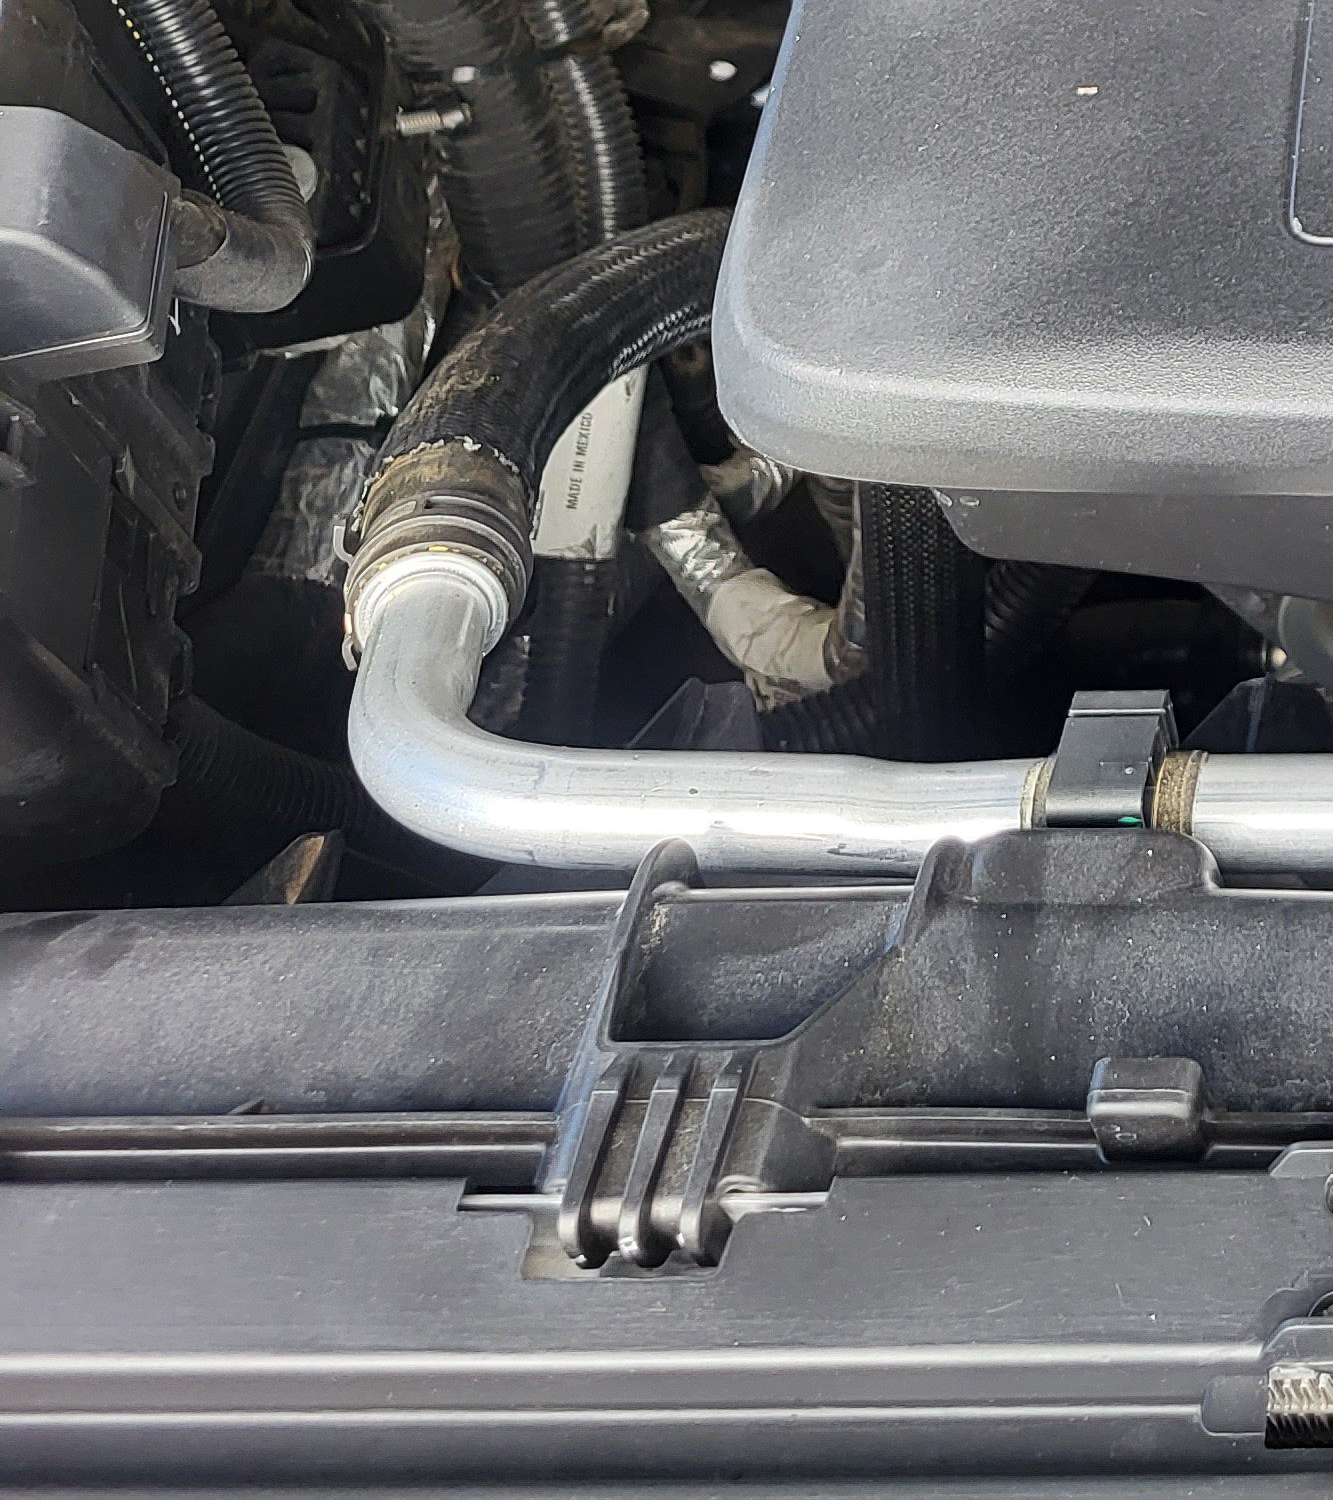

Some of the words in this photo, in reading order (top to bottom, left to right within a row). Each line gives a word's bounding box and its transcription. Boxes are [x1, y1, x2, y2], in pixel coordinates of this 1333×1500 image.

[576, 413, 593, 456] MEXICO
[572, 460, 585, 472] IN
[566, 477, 582, 509] MADE
